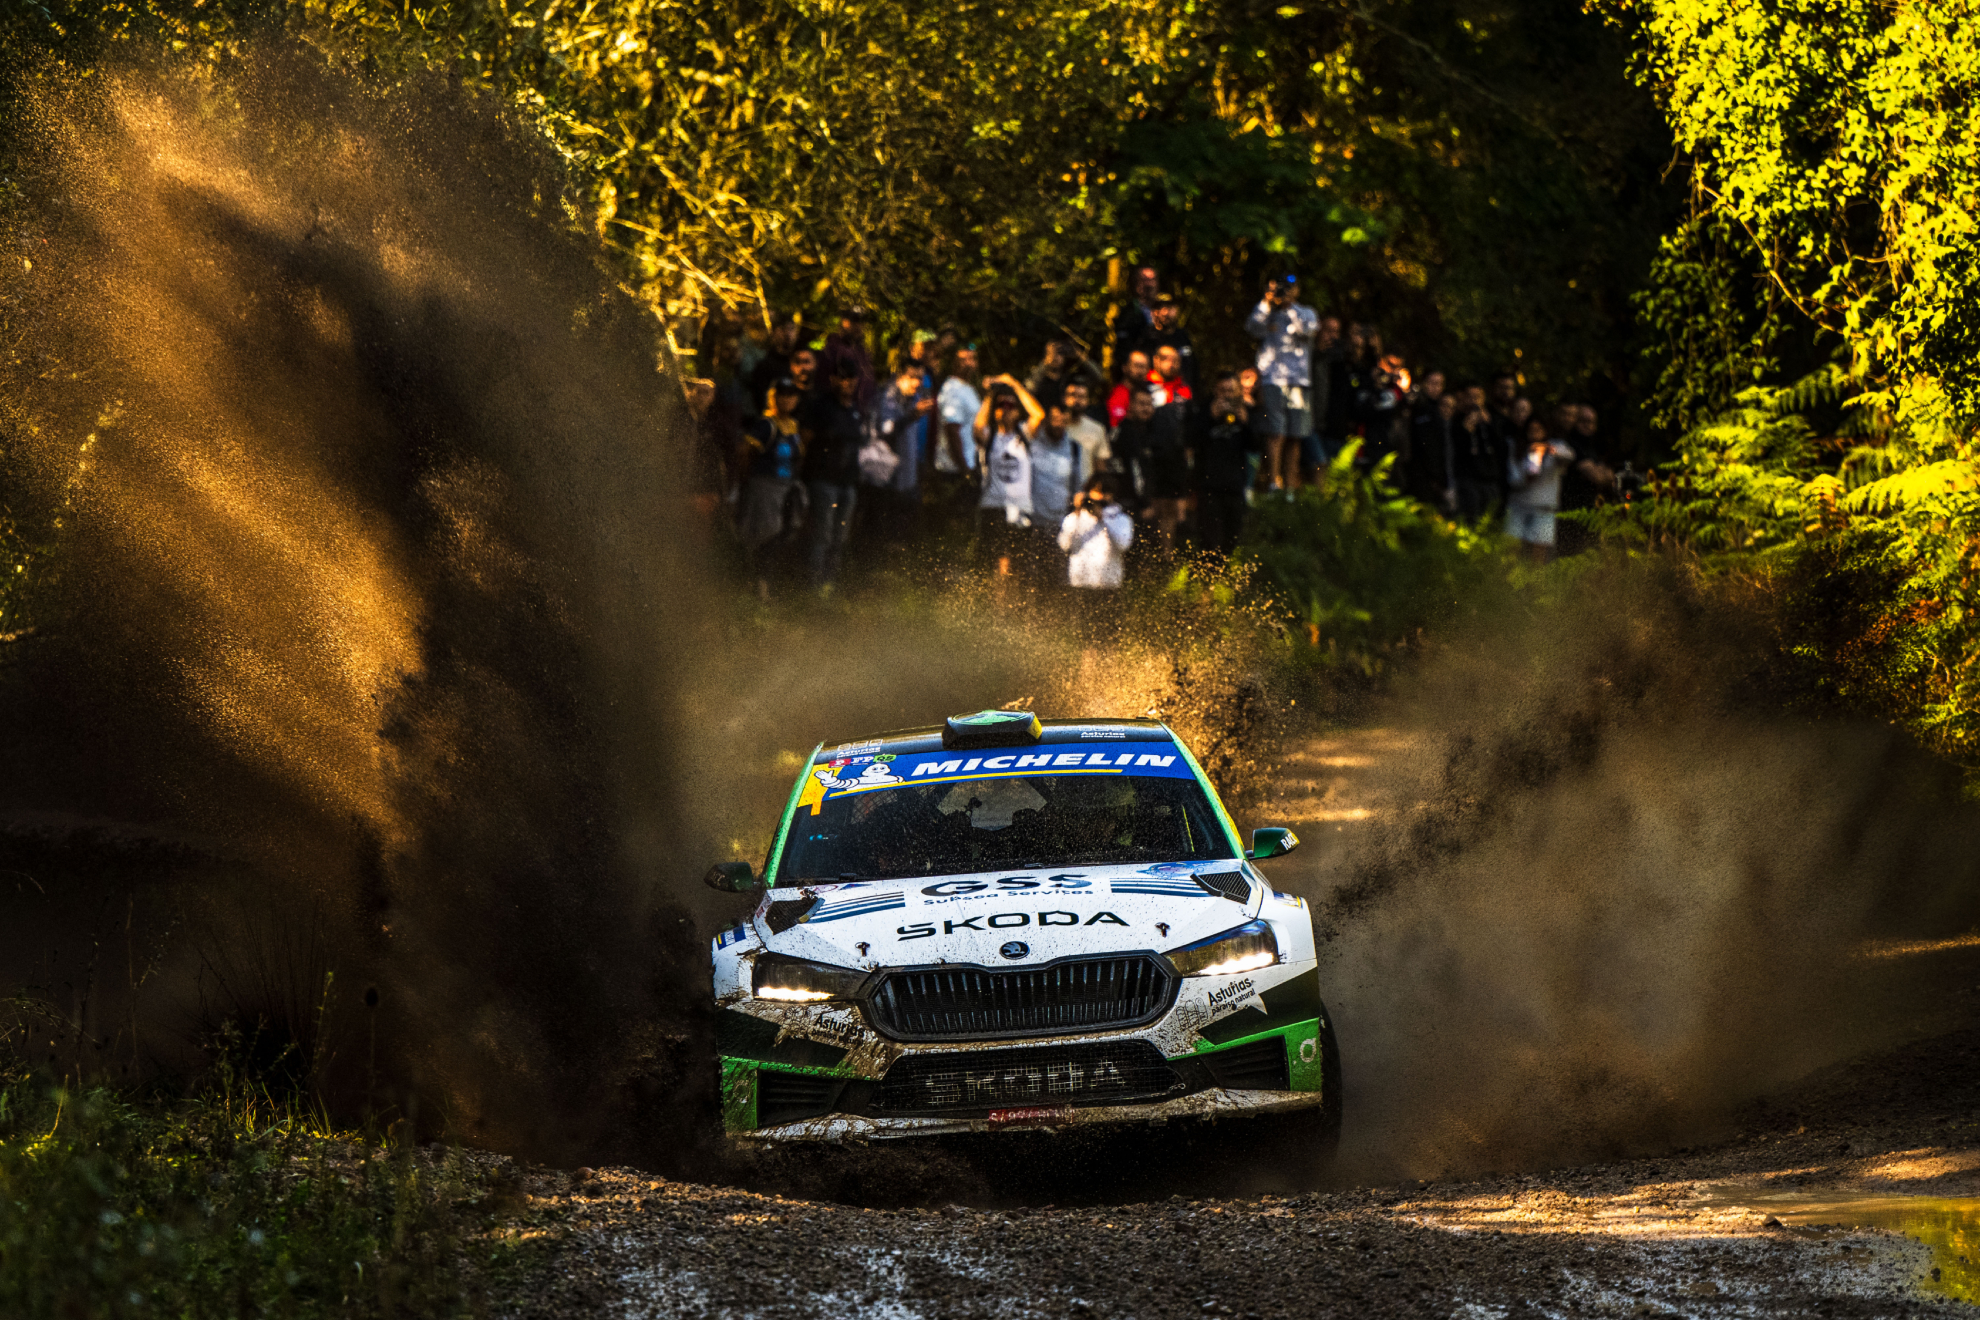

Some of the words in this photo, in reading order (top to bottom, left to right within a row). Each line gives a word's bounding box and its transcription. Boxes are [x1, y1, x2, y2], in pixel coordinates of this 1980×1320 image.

[911, 753, 1177, 776] MICHELIN
[921, 874, 1093, 897] GSS
[923, 893, 999, 906] Subsea
[1007, 889, 1094, 897] Services
[1208, 977, 1252, 1006] Asturias
